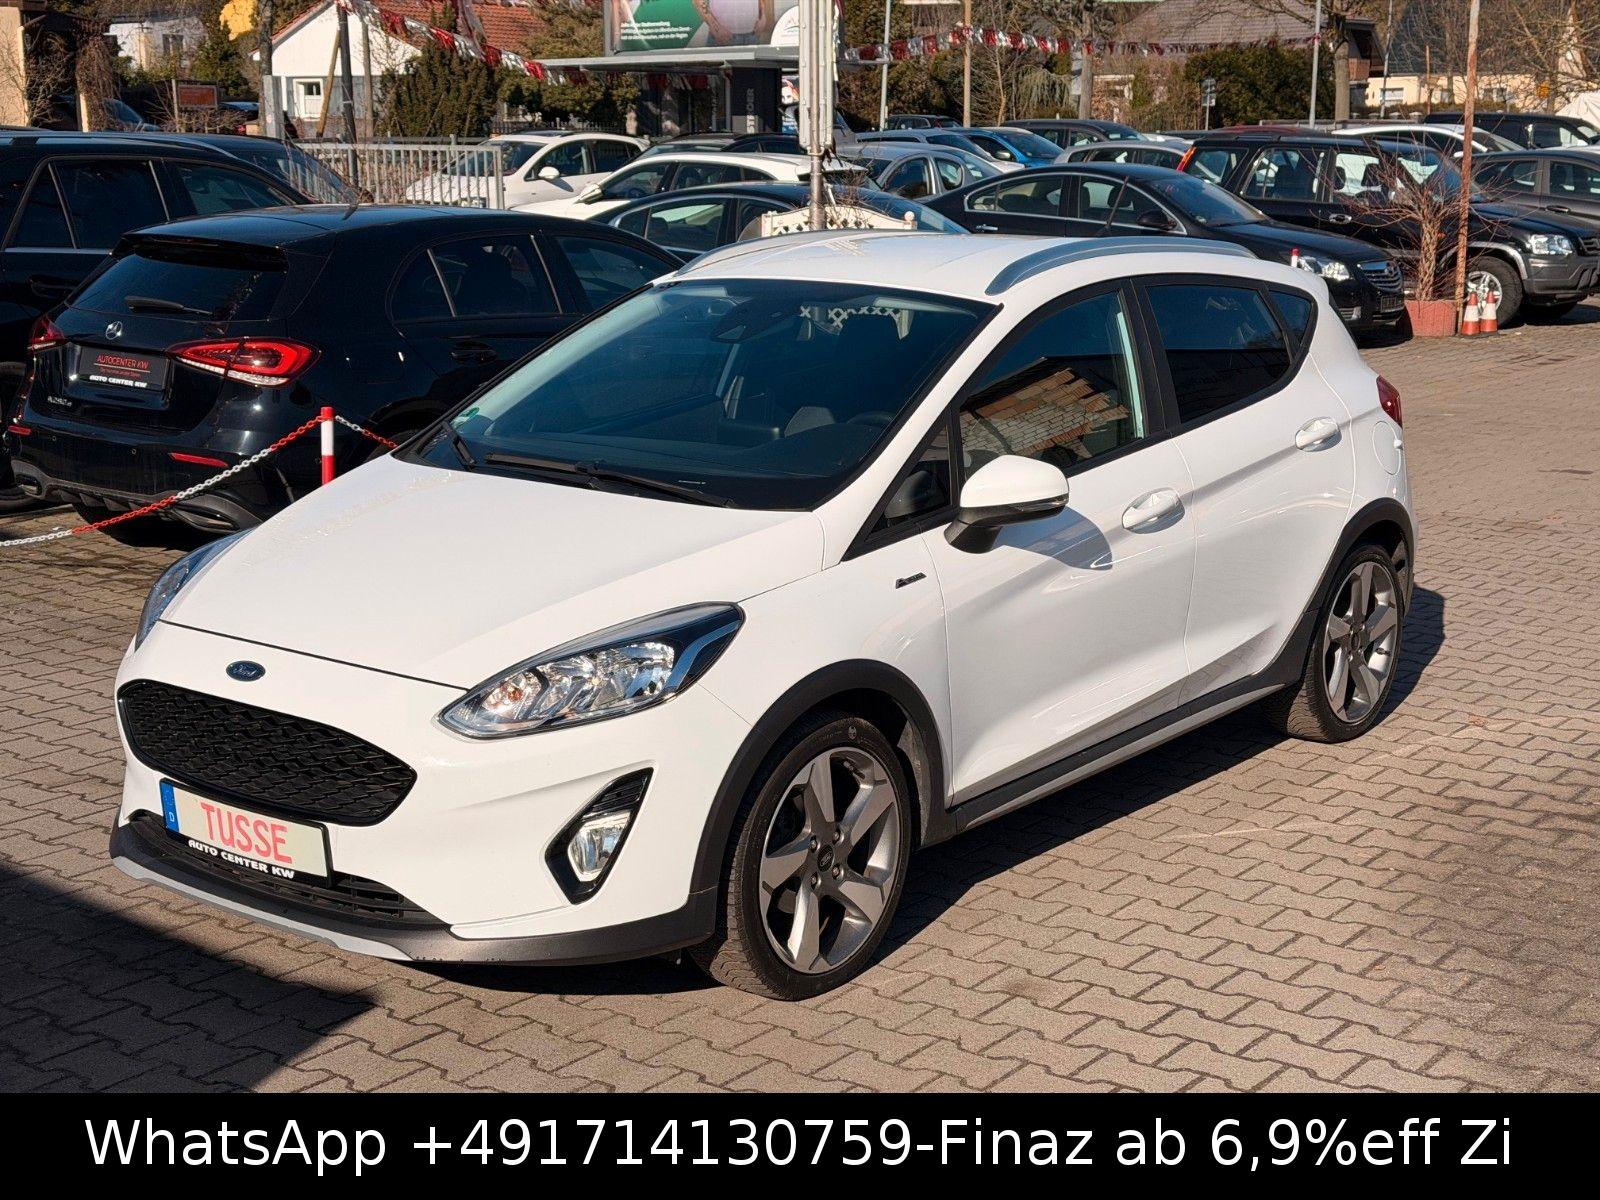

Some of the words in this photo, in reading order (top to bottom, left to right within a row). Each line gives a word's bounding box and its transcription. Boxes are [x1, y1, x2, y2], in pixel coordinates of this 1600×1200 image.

[97, 355, 136, 367] AUTOCENTER
[137, 360, 149, 369] KW
[89, 375, 108, 383] AUTO
[108, 377, 134, 386] CENTER
[200, 801, 293, 864] TUSSE
[188, 839, 219, 857] AUTO
[220, 850, 269, 874] CENTER
[271, 865, 296, 880] KW
